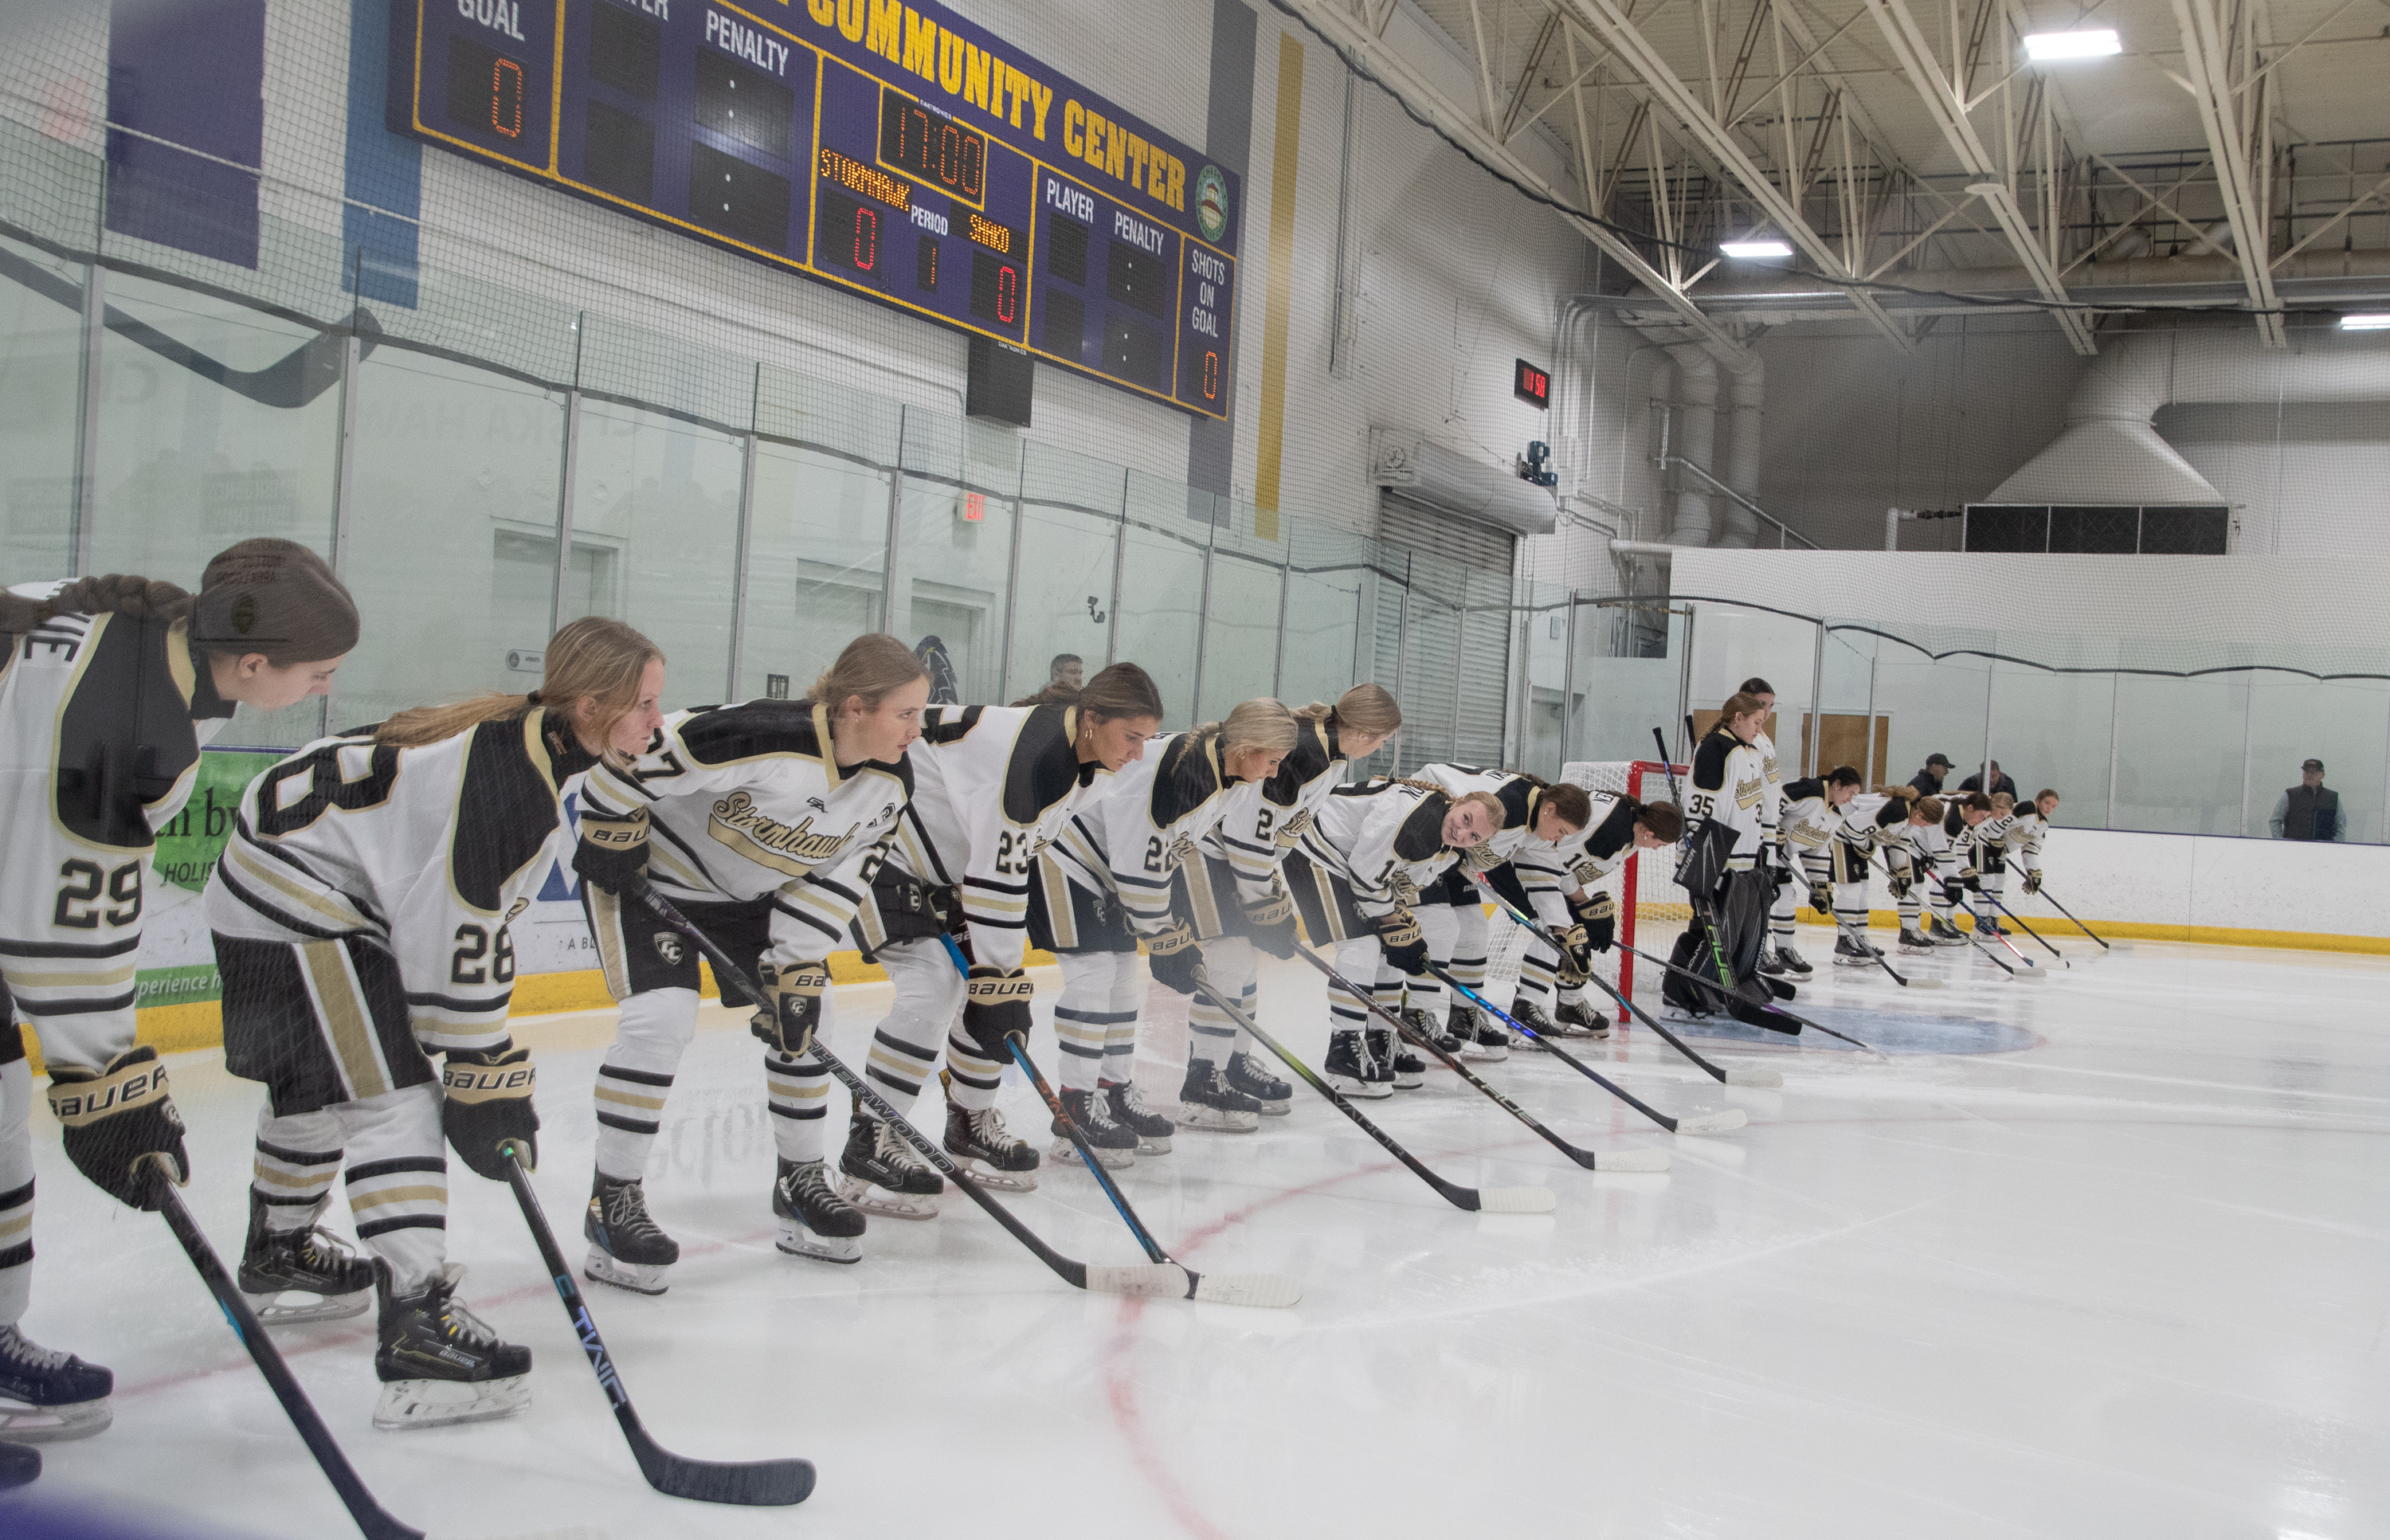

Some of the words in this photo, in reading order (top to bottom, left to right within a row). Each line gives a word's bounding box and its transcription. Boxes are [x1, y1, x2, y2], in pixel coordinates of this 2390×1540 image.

[706, 9, 789, 76] PENALTY
[492, 57, 523, 138] 0
[899, 107, 981, 195] 17:00
[1064, 99, 1185, 212] CENTER
[821, 148, 910, 211] STORMHAWK
[1047, 178, 1094, 224] PLAYER
[854, 207, 876, 270] 0
[911, 205, 949, 236] PERIOD
[1115, 210, 1164, 255] PENALTY
[1192, 249, 1225, 286] SHOTS
[998, 265, 1016, 323] 0
[1200, 281, 1215, 308] ON
[1192, 307, 1218, 338] GOAL
[966, 493, 985, 521] EXIT
[1688, 794, 1714, 817] 35
[996, 829, 1029, 876] 23
[53, 857, 143, 931] 29
[451, 922, 516, 986] 28
